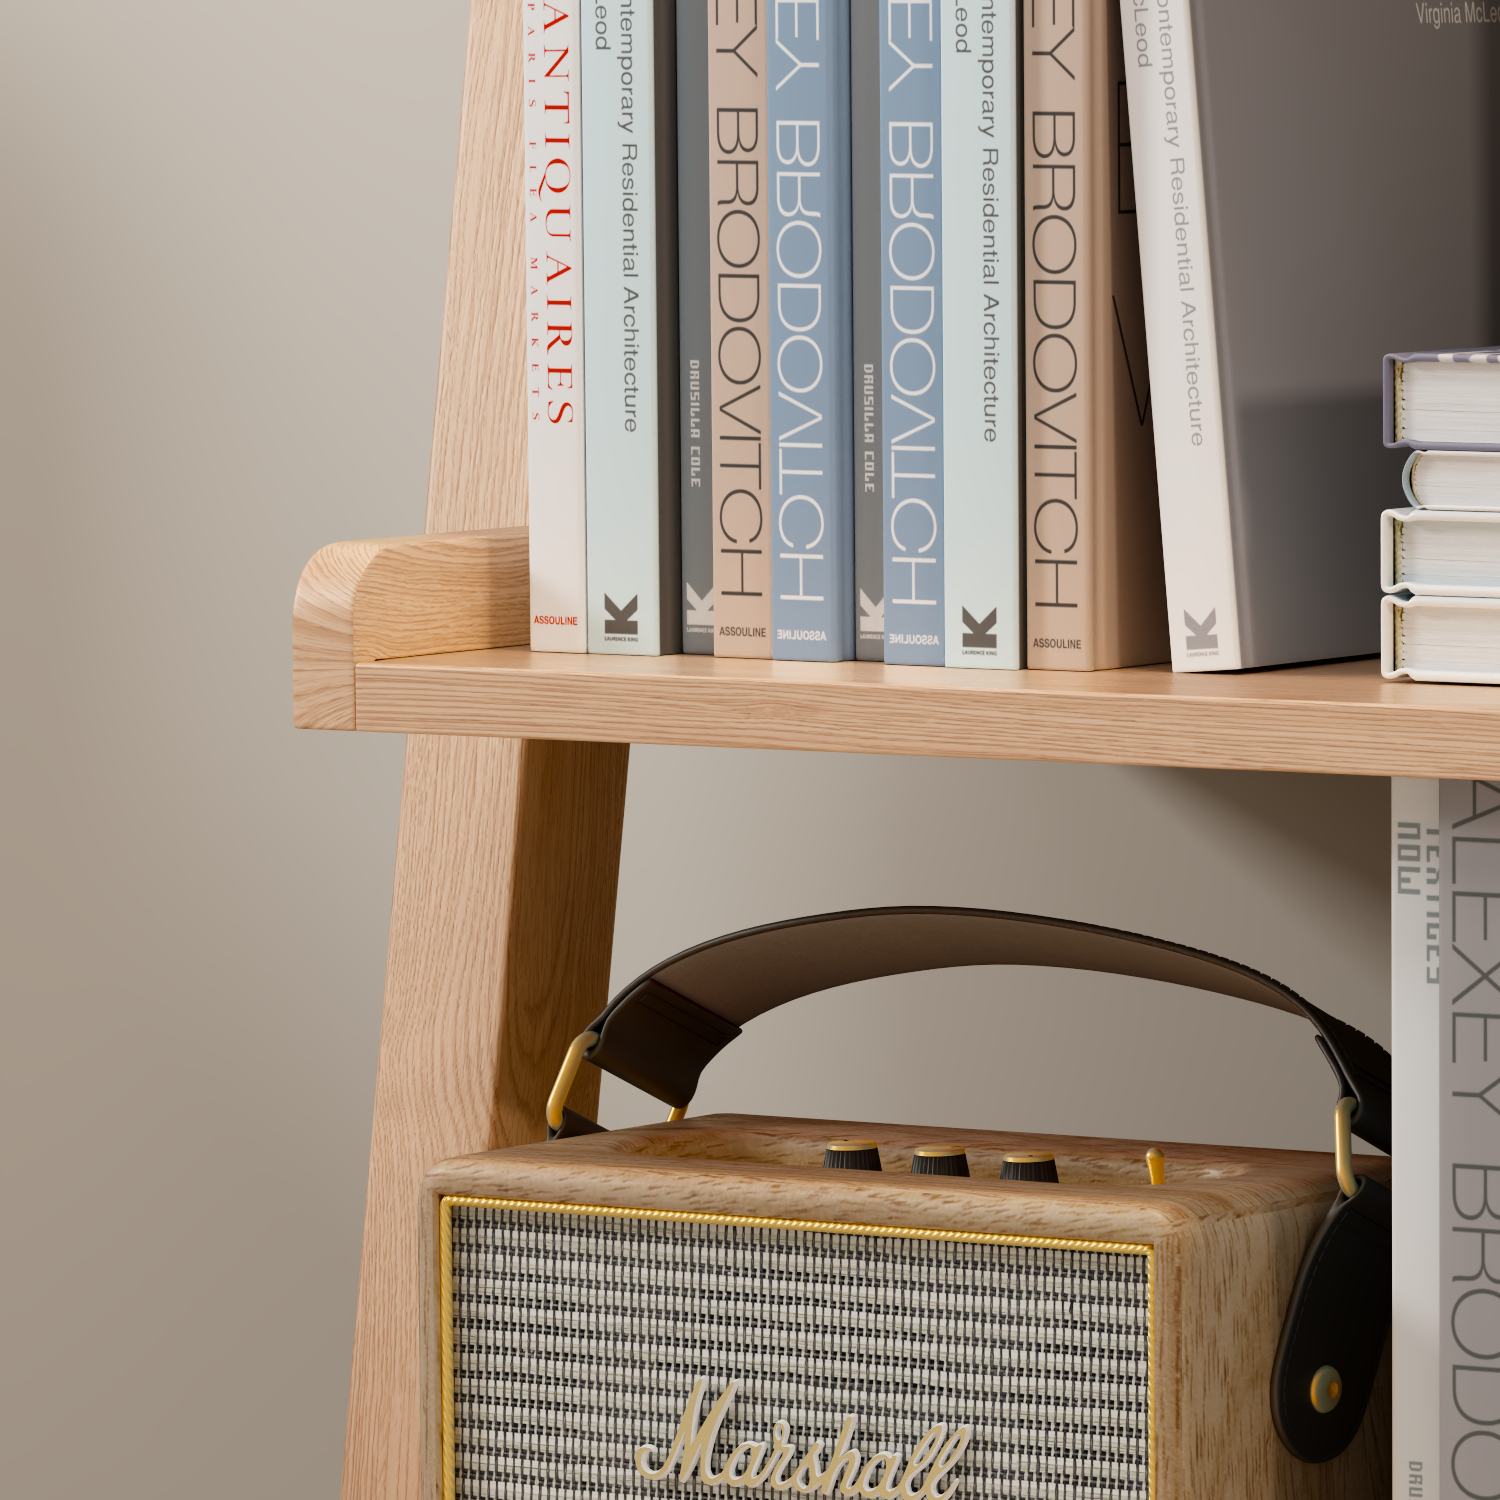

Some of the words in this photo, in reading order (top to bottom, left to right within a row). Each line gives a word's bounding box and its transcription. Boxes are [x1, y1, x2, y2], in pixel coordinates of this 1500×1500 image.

[527, 2, 537, 108] PARIS
[1415, 2, 1462, 29] Virginia
[529, 142, 538, 223] FLEA
[538, 2, 574, 424] ANTIQUAIRES
[621, 143, 639, 278] Residential
[982, 147, 999, 285] Residential
[1169, 157, 1195, 292] Residential
[530, 257, 540, 421] MARKETS
[622, 286, 640, 433] Architecture
[716, 108, 763, 597] BRODOVITCH
[983, 293, 1001, 443] Architecture
[1032, 111, 1079, 608] BRODOVITCH
[1180, 301, 1204, 447] Architecture
[690, 445, 701, 488] COLE
[864, 450, 875, 493] COLE
[533, 614, 578, 626] ASSOULINE
[719, 625, 767, 638] ASSOULINE
[1033, 637, 1082, 650] ASSOULINE
[1397, 821, 1421, 895] NOW
